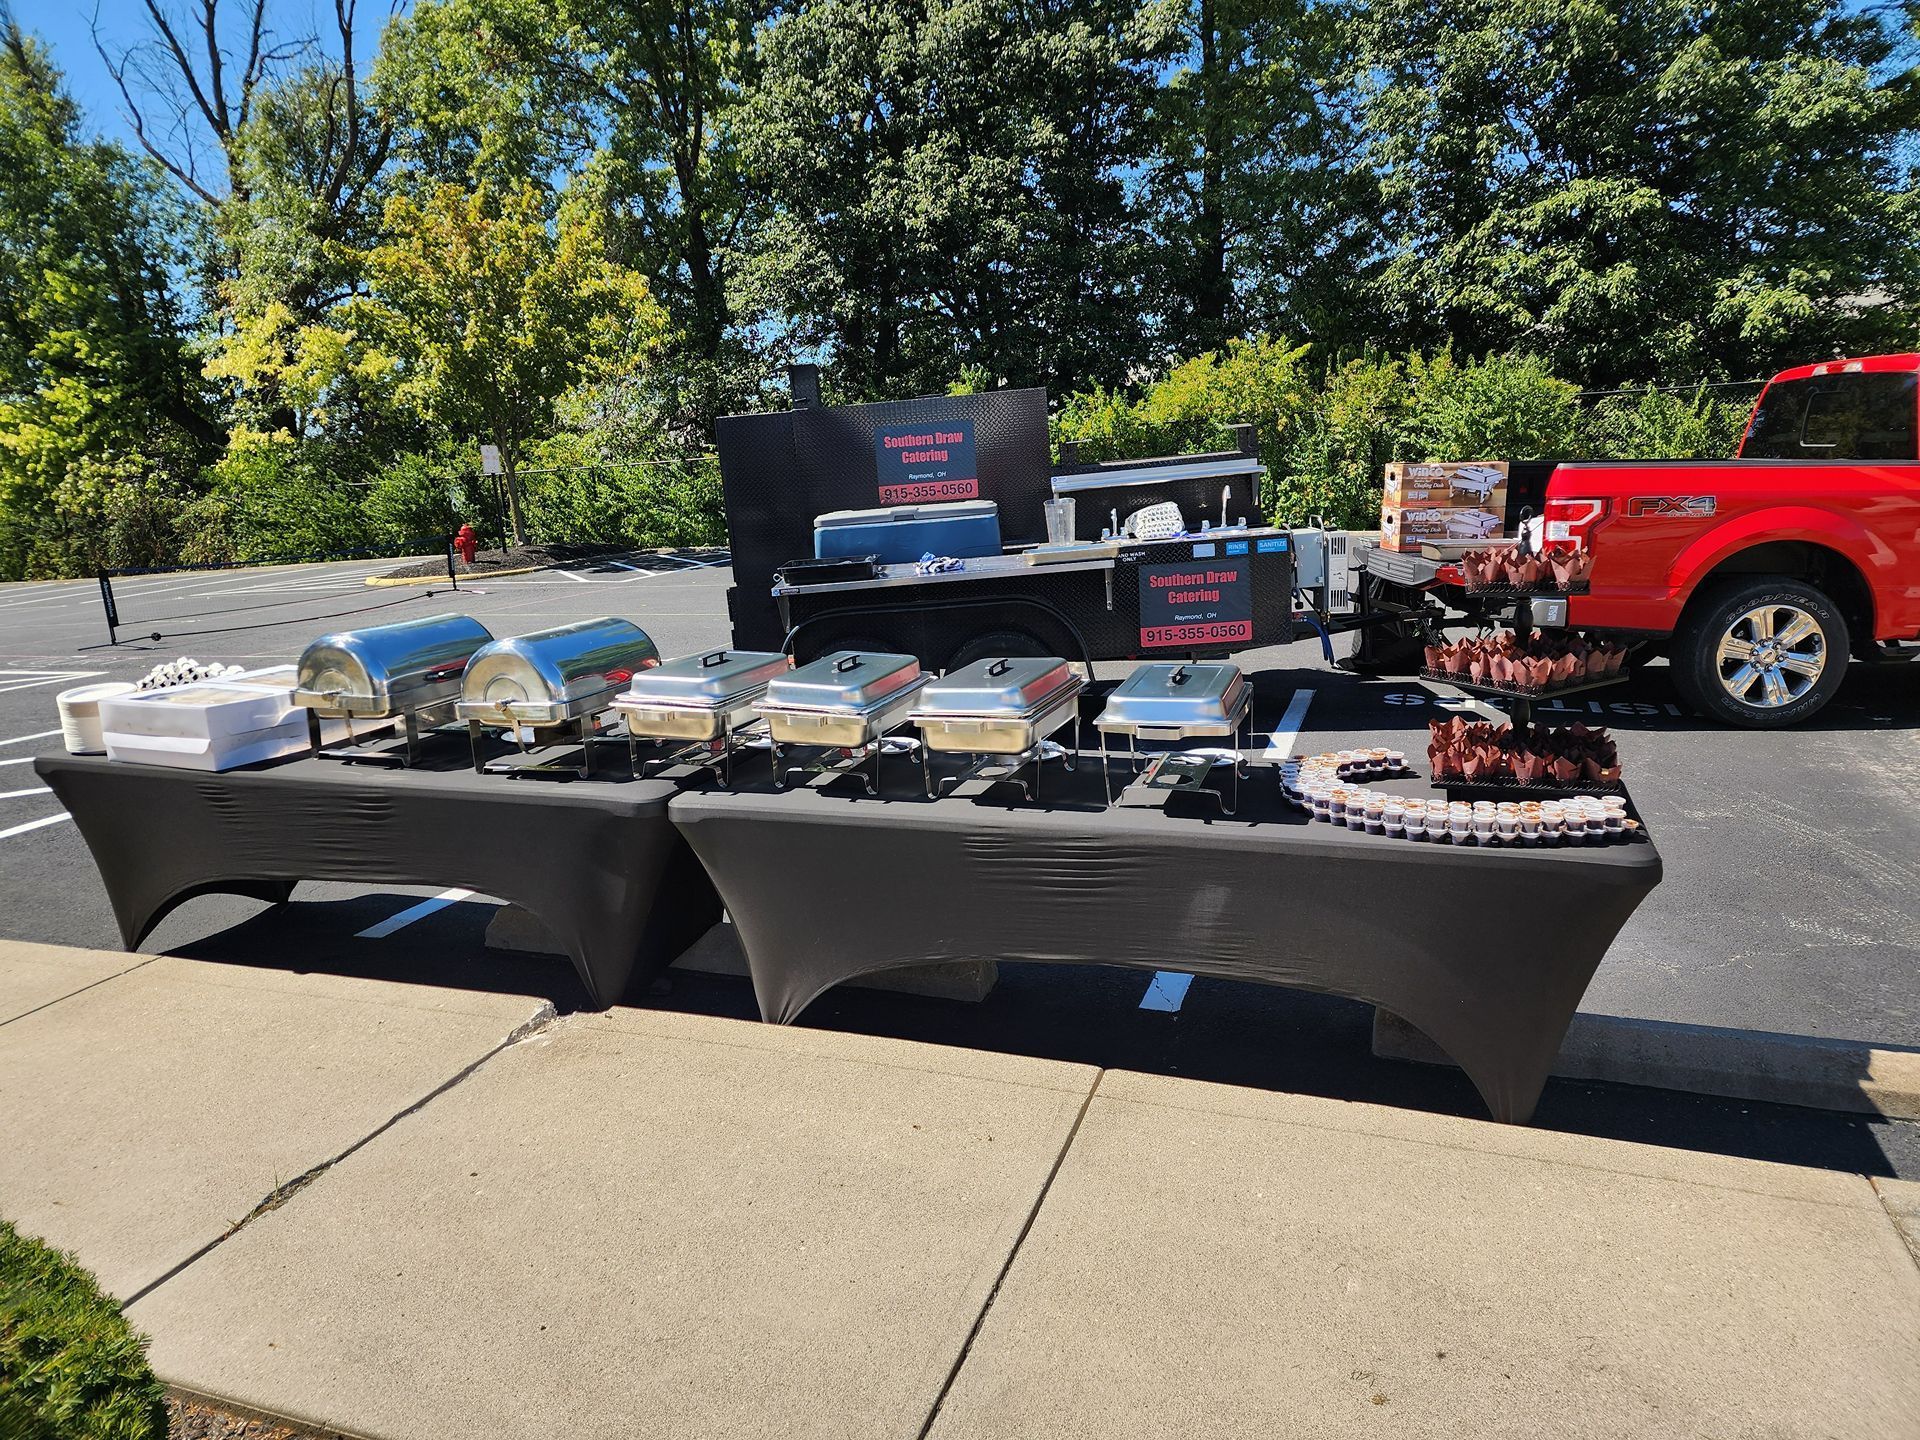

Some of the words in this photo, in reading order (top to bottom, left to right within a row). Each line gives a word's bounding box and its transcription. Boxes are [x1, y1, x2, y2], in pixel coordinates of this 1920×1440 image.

[884, 434, 933, 448] Southern
[935, 432, 963, 444] Draw
[902, 450, 948, 463] Catering
[884, 482, 973, 500] 915-355-0560
[1628, 496, 1716, 517] FX4
[1259, 540, 1286, 548] SANITIZE
[1150, 573, 1204, 588] Southern
[1206, 571, 1238, 584] Draw
[1168, 589, 1220, 604] Catering
[1174, 613, 1204, 622] Raymond,
[1146, 624, 1246, 642] 915-355-0560
